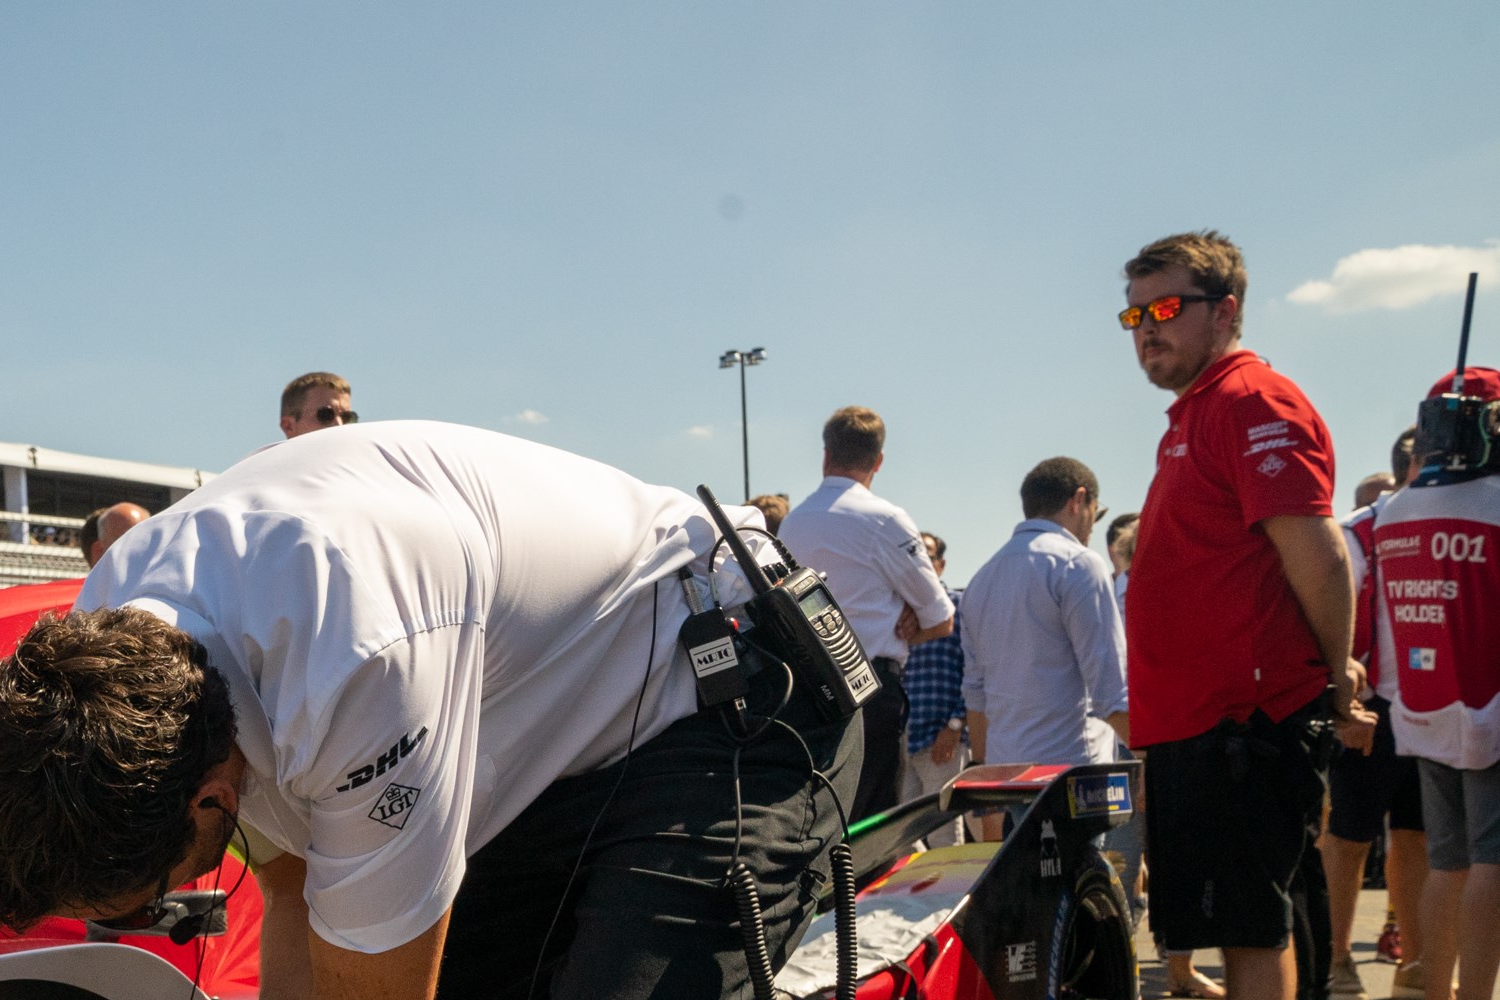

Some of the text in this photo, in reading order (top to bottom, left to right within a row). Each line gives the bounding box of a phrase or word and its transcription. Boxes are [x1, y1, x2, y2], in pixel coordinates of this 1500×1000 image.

[1432, 532, 1487, 563] 001
[342, 729, 424, 792] DHL
[378, 790, 414, 821] LGT
